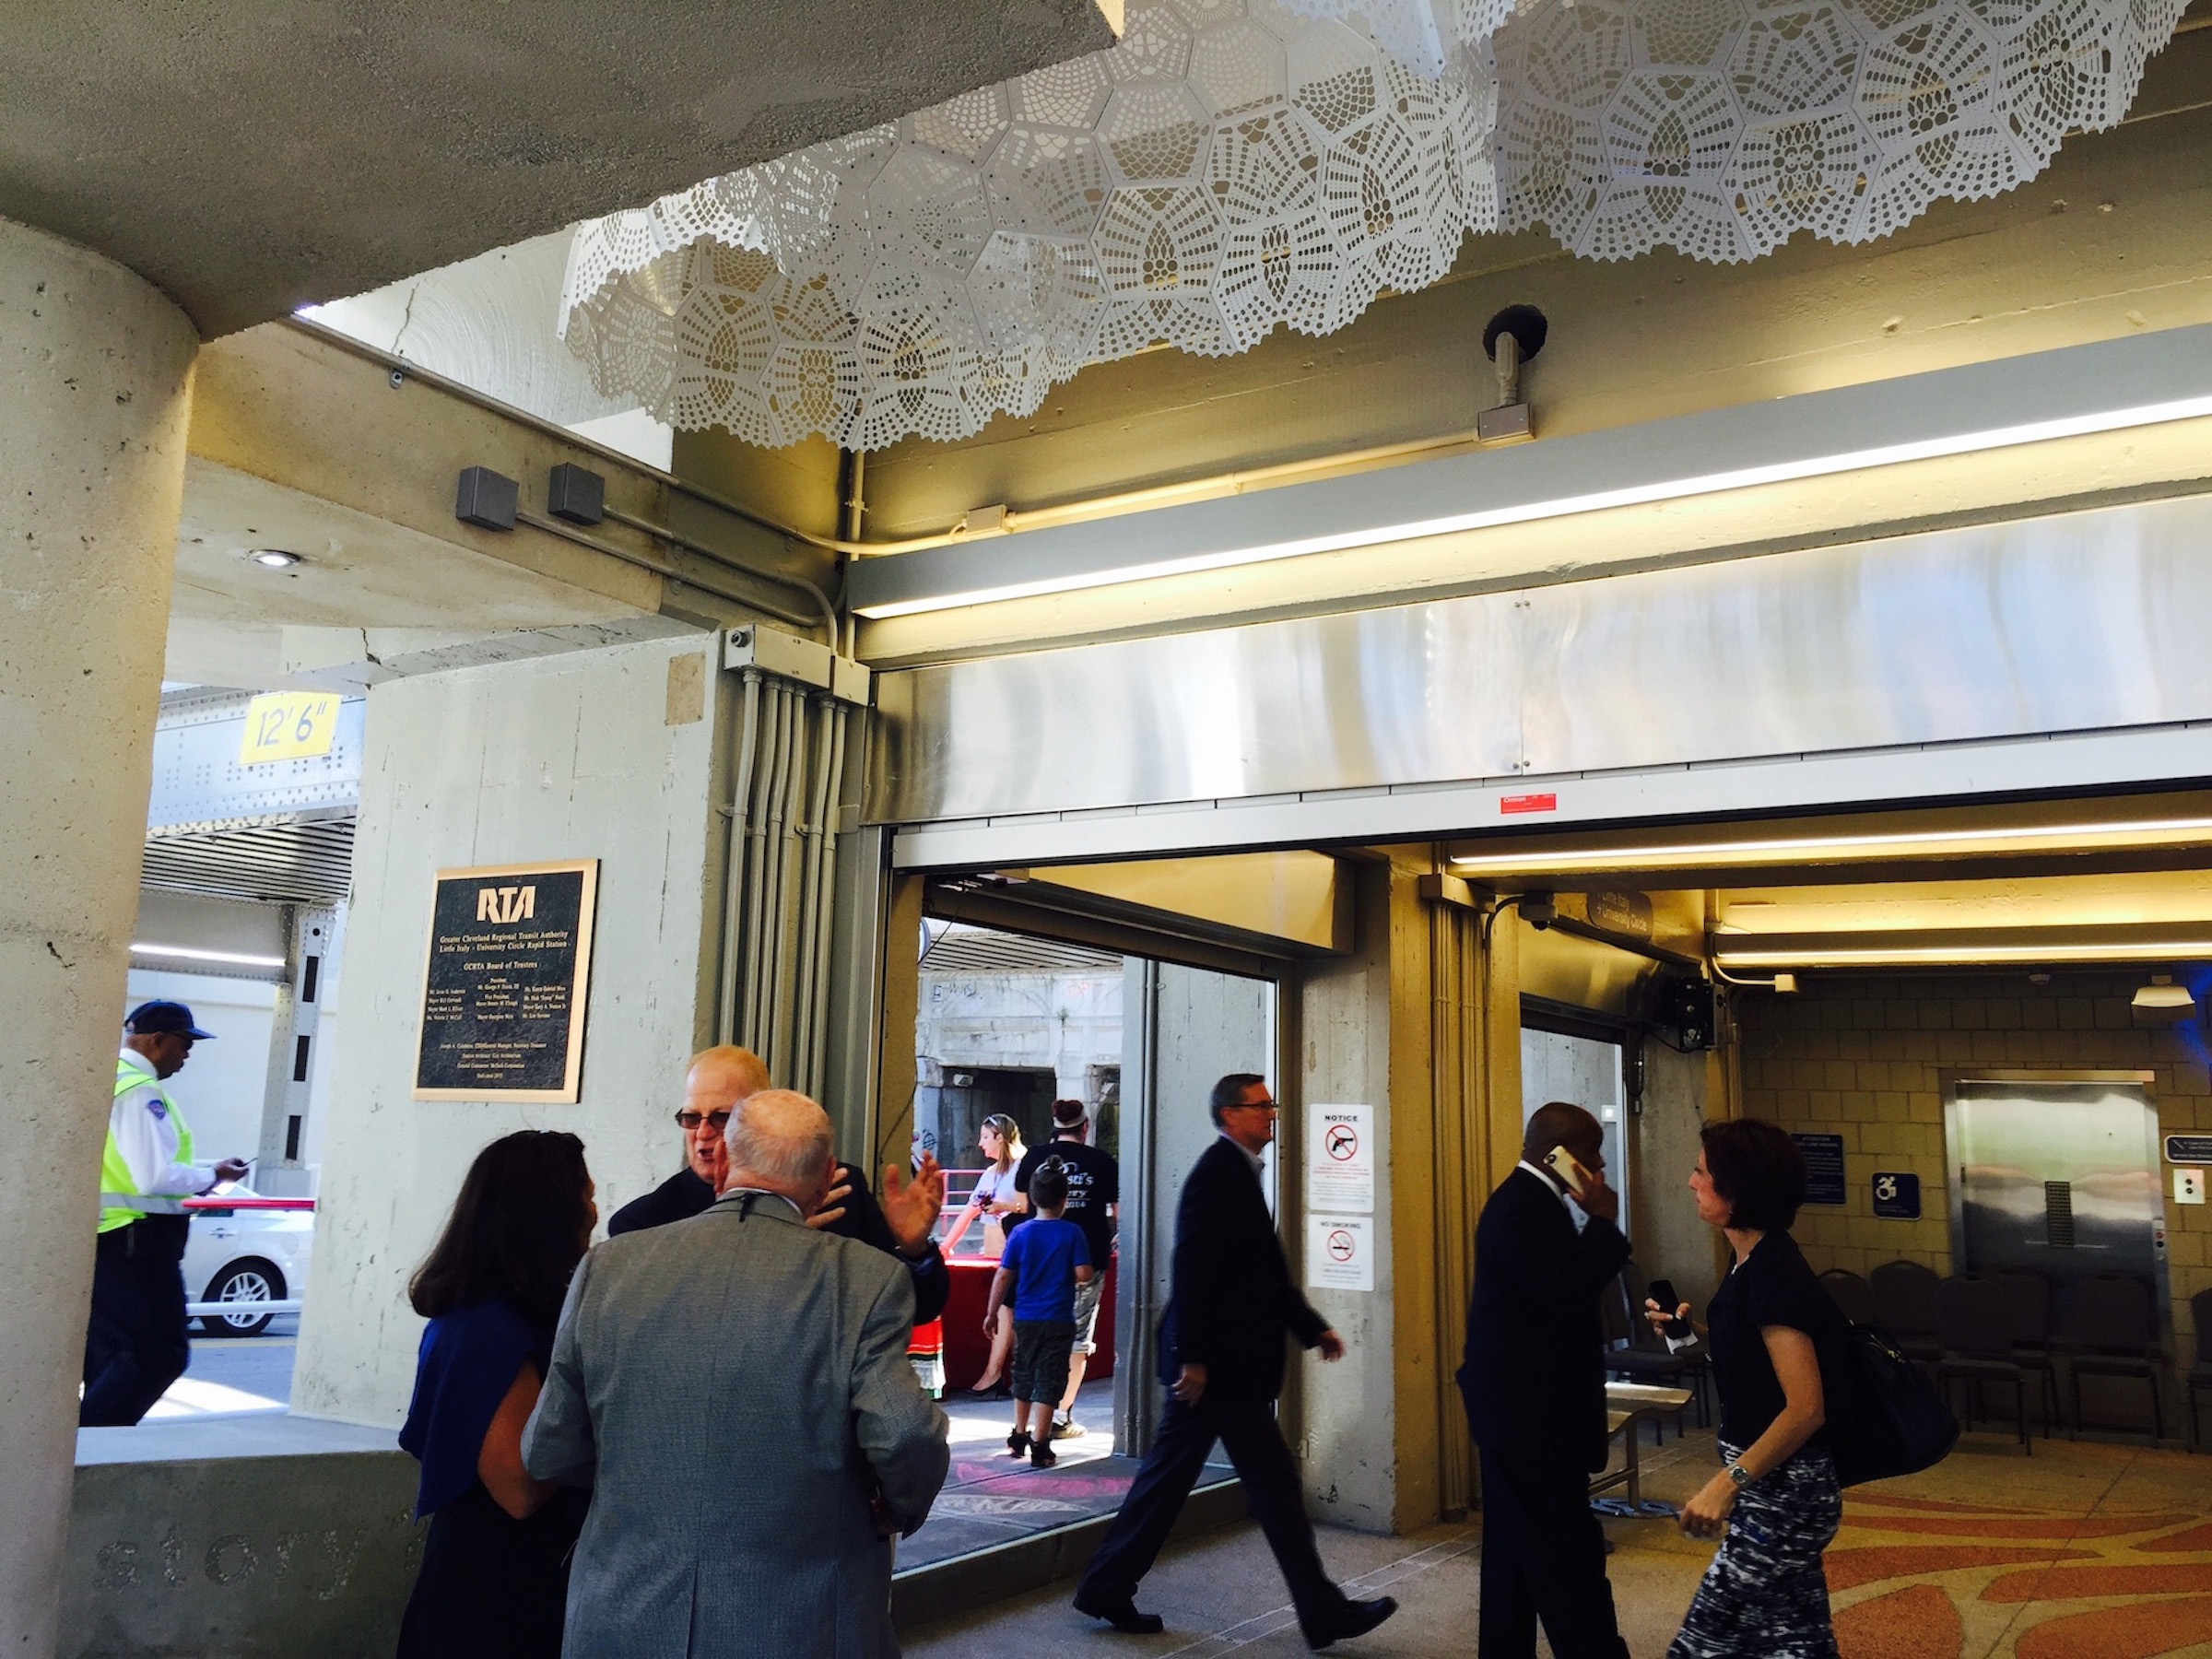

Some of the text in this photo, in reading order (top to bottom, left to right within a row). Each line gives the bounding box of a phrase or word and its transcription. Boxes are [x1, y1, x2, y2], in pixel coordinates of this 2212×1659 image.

[477, 886, 536, 924] RTA
[440, 930, 568, 944] Greater Cleveland Regional Transit Authority
[439, 945, 455, 953] Little
[456, 945, 470, 954] Italy
[477, 943, 506, 952] University
[507, 941, 525, 949] Circle
[527, 940, 545, 950] Rapid
[546, 940, 567, 948] Station
[463, 960, 538, 971] GCRTA Board of Trustees
